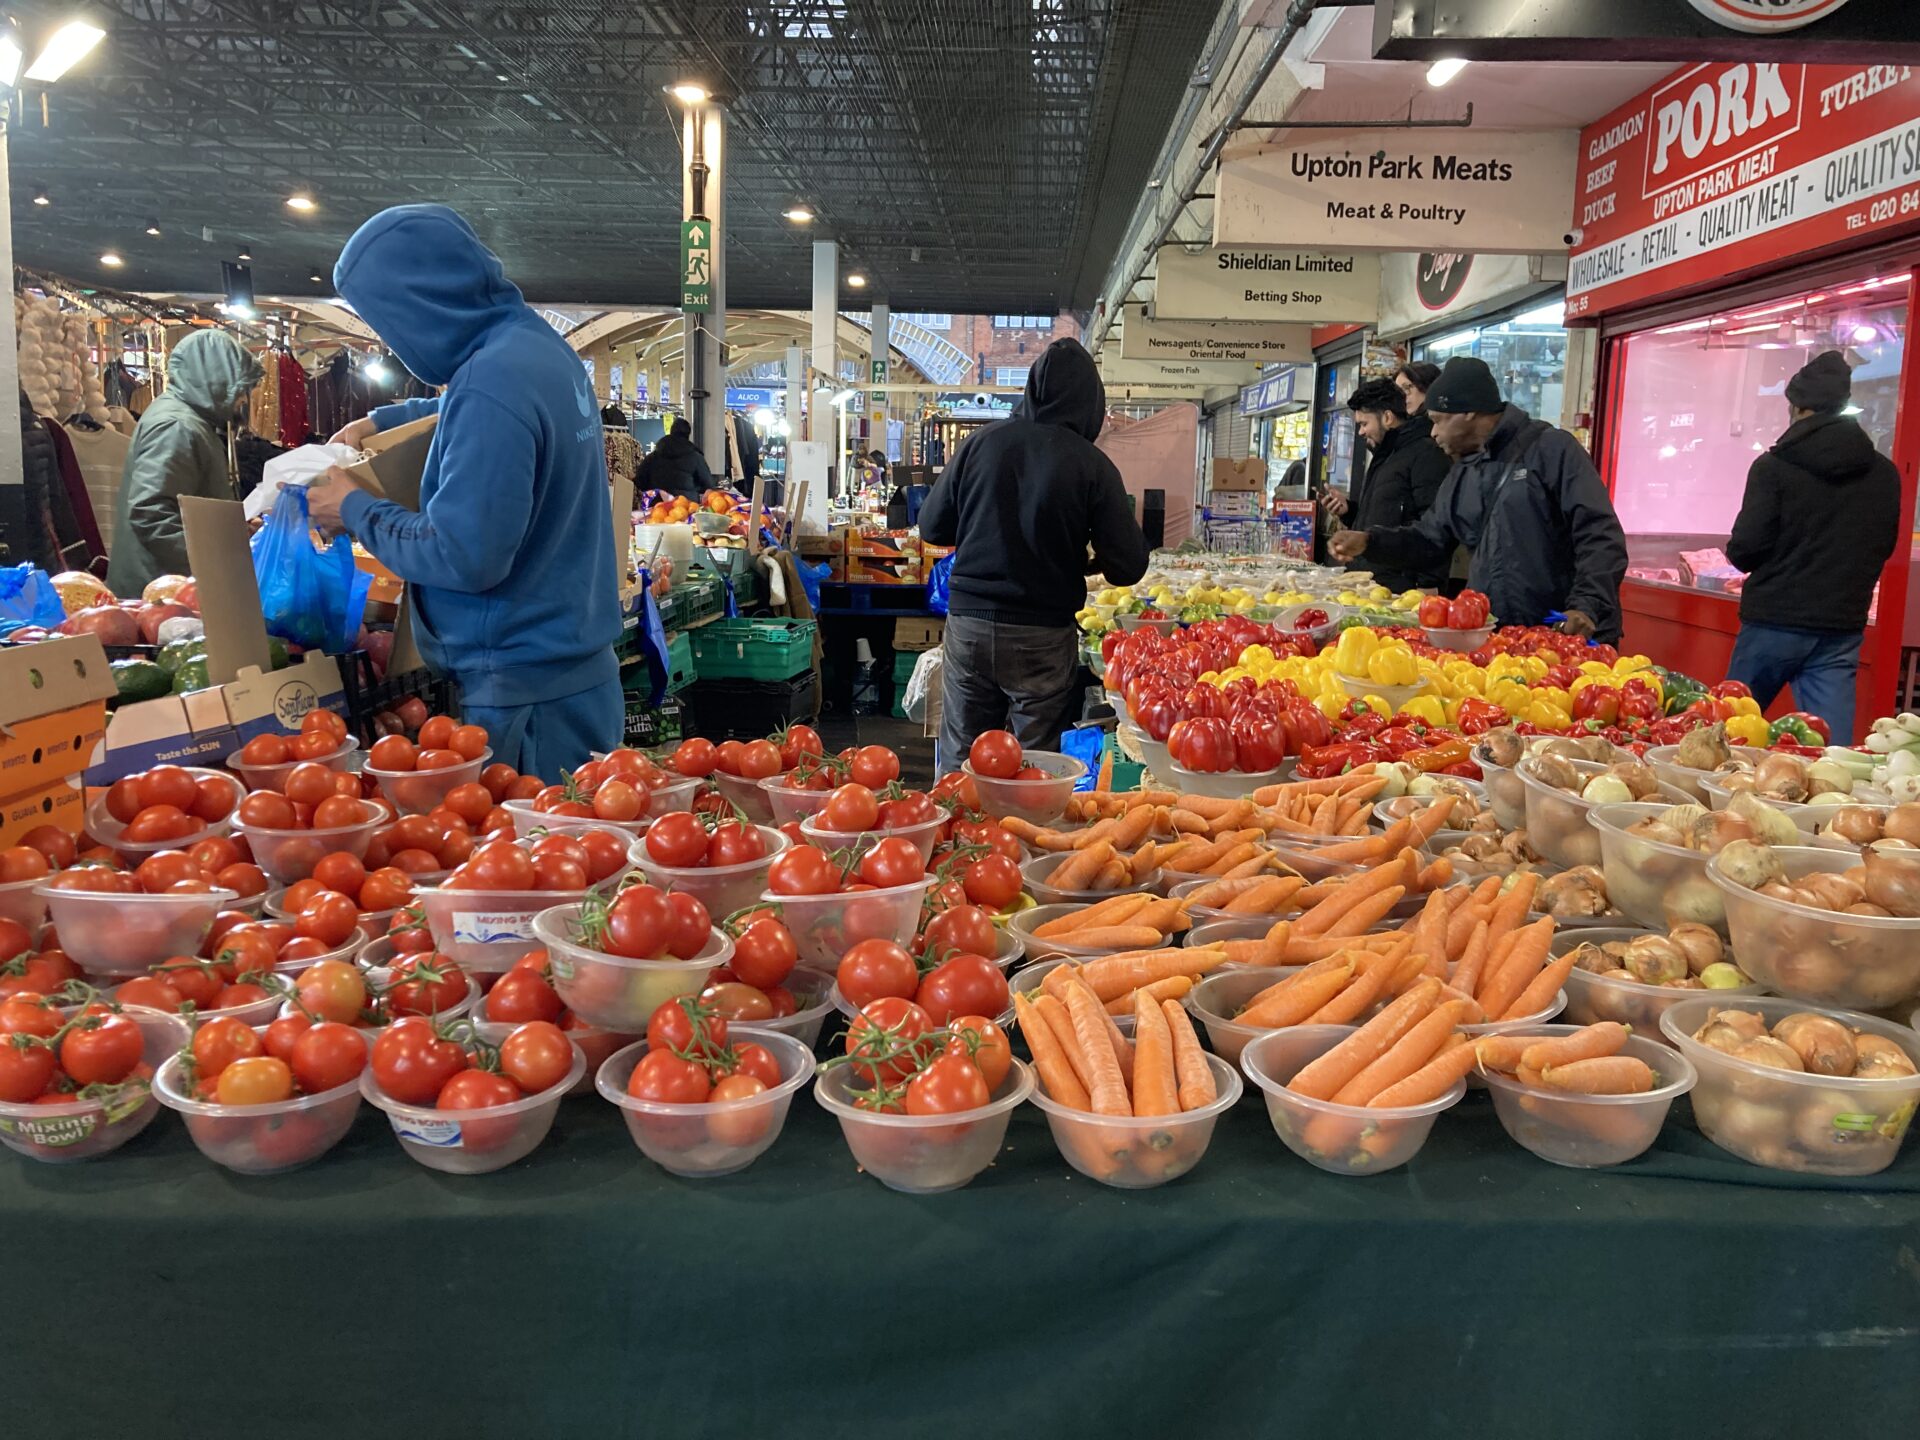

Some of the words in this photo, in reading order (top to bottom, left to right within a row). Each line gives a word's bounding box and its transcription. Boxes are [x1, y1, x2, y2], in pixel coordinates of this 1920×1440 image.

[1653, 63, 1790, 175] PORK
[1589, 111, 1645, 160] GAMMON
[1291, 152, 1362, 182] Upton
[1368, 155, 1423, 179] Park
[1432, 155, 1512, 181] Meats
[1585, 160, 1617, 194] BEEF
[1653, 181, 1695, 219] UPTON
[1698, 164, 1735, 202] PARK
[1737, 145, 1779, 187] MEAT
[1326, 201, 1375, 219] Meat
[1380, 203, 1393, 219] &
[1399, 203, 1466, 225] Poultry
[1572, 243, 1626, 290] WHOLESALE
[1641, 222, 1677, 266] RETAIL
[1699, 191, 1755, 247] QUALITY
[1756, 174, 1799, 227] MEAT
[1825, 134, 1902, 203] QUALITY
[1582, 192, 1616, 226] DUCK
[1846, 214, 1866, 230] TEL:
[1870, 196, 1897, 223] 020
[1218, 252, 1291, 271] Shieldian
[1295, 254, 1354, 272] Limited
[684, 293, 708, 305] Exit
[1244, 290, 1288, 304] Betting
[1292, 291, 1322, 304] Shop
[1579, 296, 1589, 312] 55
[1189, 350, 1223, 359] Oriental
[1225, 350, 1246, 359] Food
[1262, 340, 1286, 350] Store
[1160, 366, 1185, 375] Frozen
[1185, 366, 1200, 374] Fish
[576, 425, 594, 443] NIKE
[624, 712, 651, 724] rima
[155, 750, 181, 761] Taste
[182, 745, 199, 757] the
[199, 740, 221, 752] SUN
[56, 791, 80, 807] GUAVA
[12, 805, 38, 821] GUAVA
[17, 1114, 96, 1133] Mixing
[33, 1127, 83, 1144] Bowl
